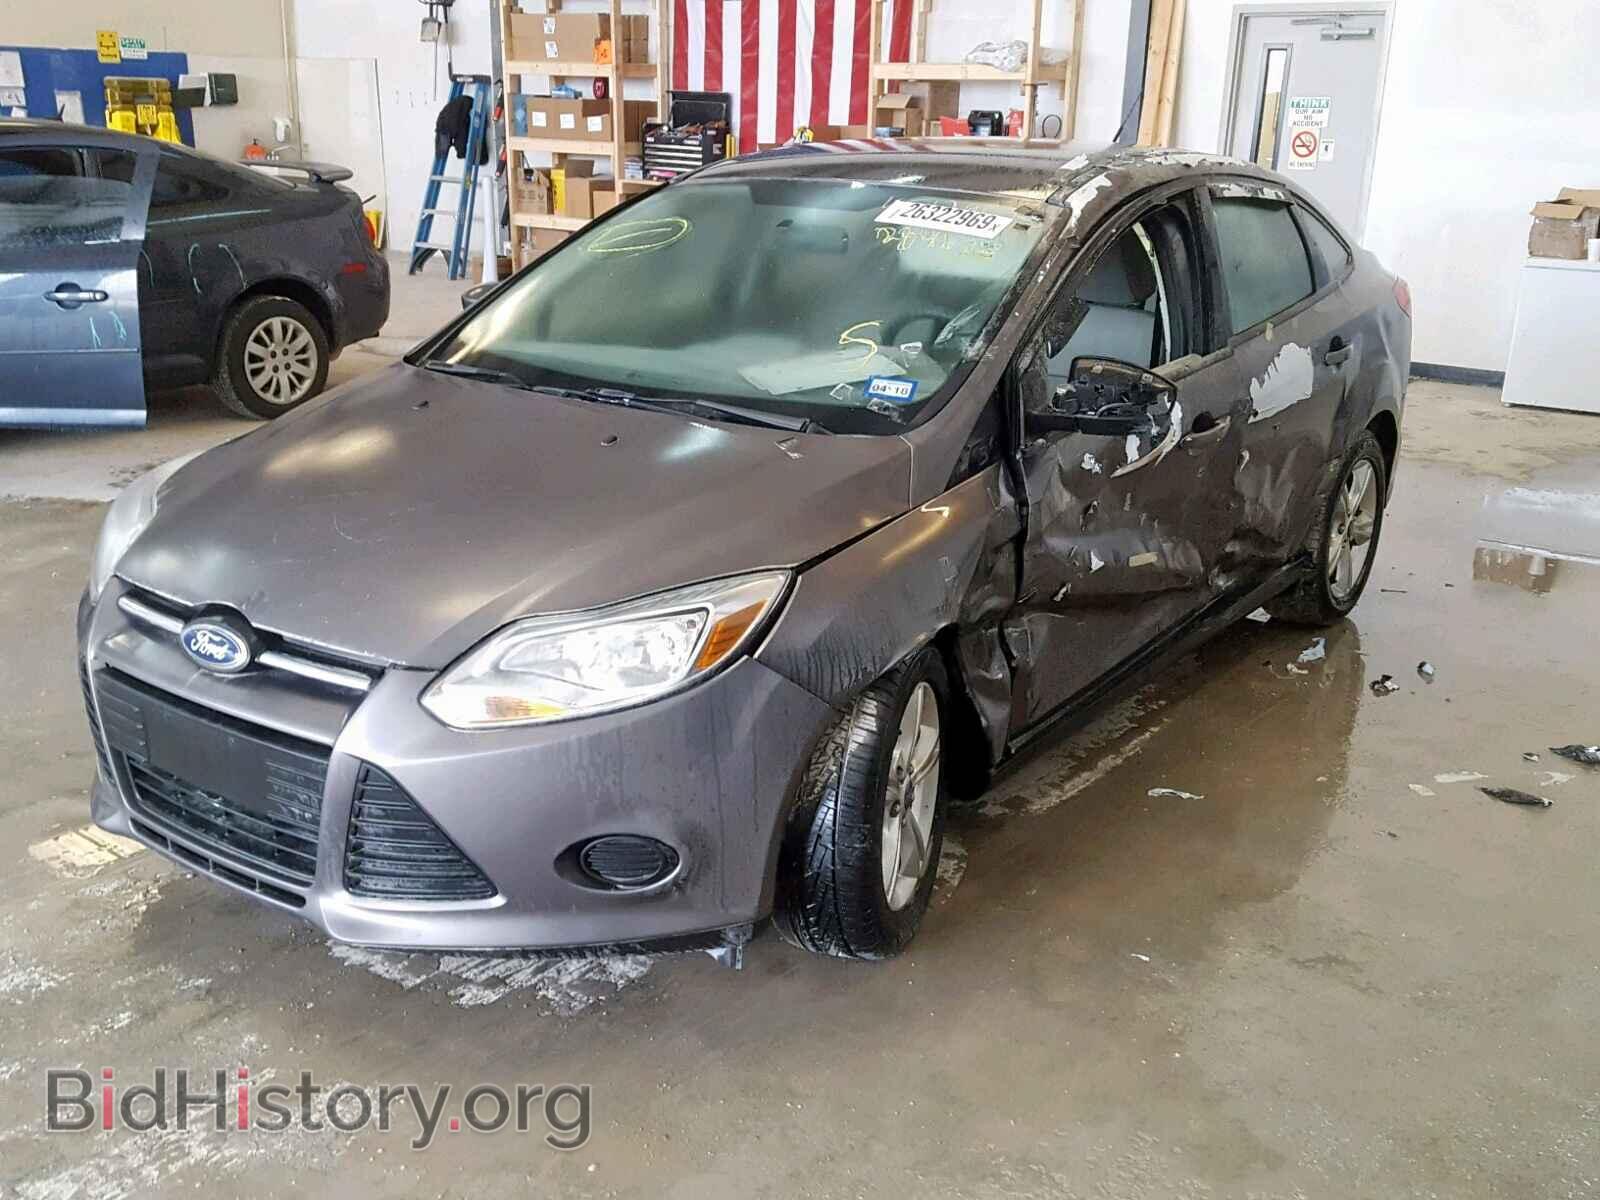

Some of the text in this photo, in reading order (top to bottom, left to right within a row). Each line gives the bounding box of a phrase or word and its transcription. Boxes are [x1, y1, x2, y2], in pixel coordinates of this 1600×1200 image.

[1290, 98, 1329, 108] THINK
[900, 203, 997, 230] 26322969
[190, 629, 231, 661] Ford
